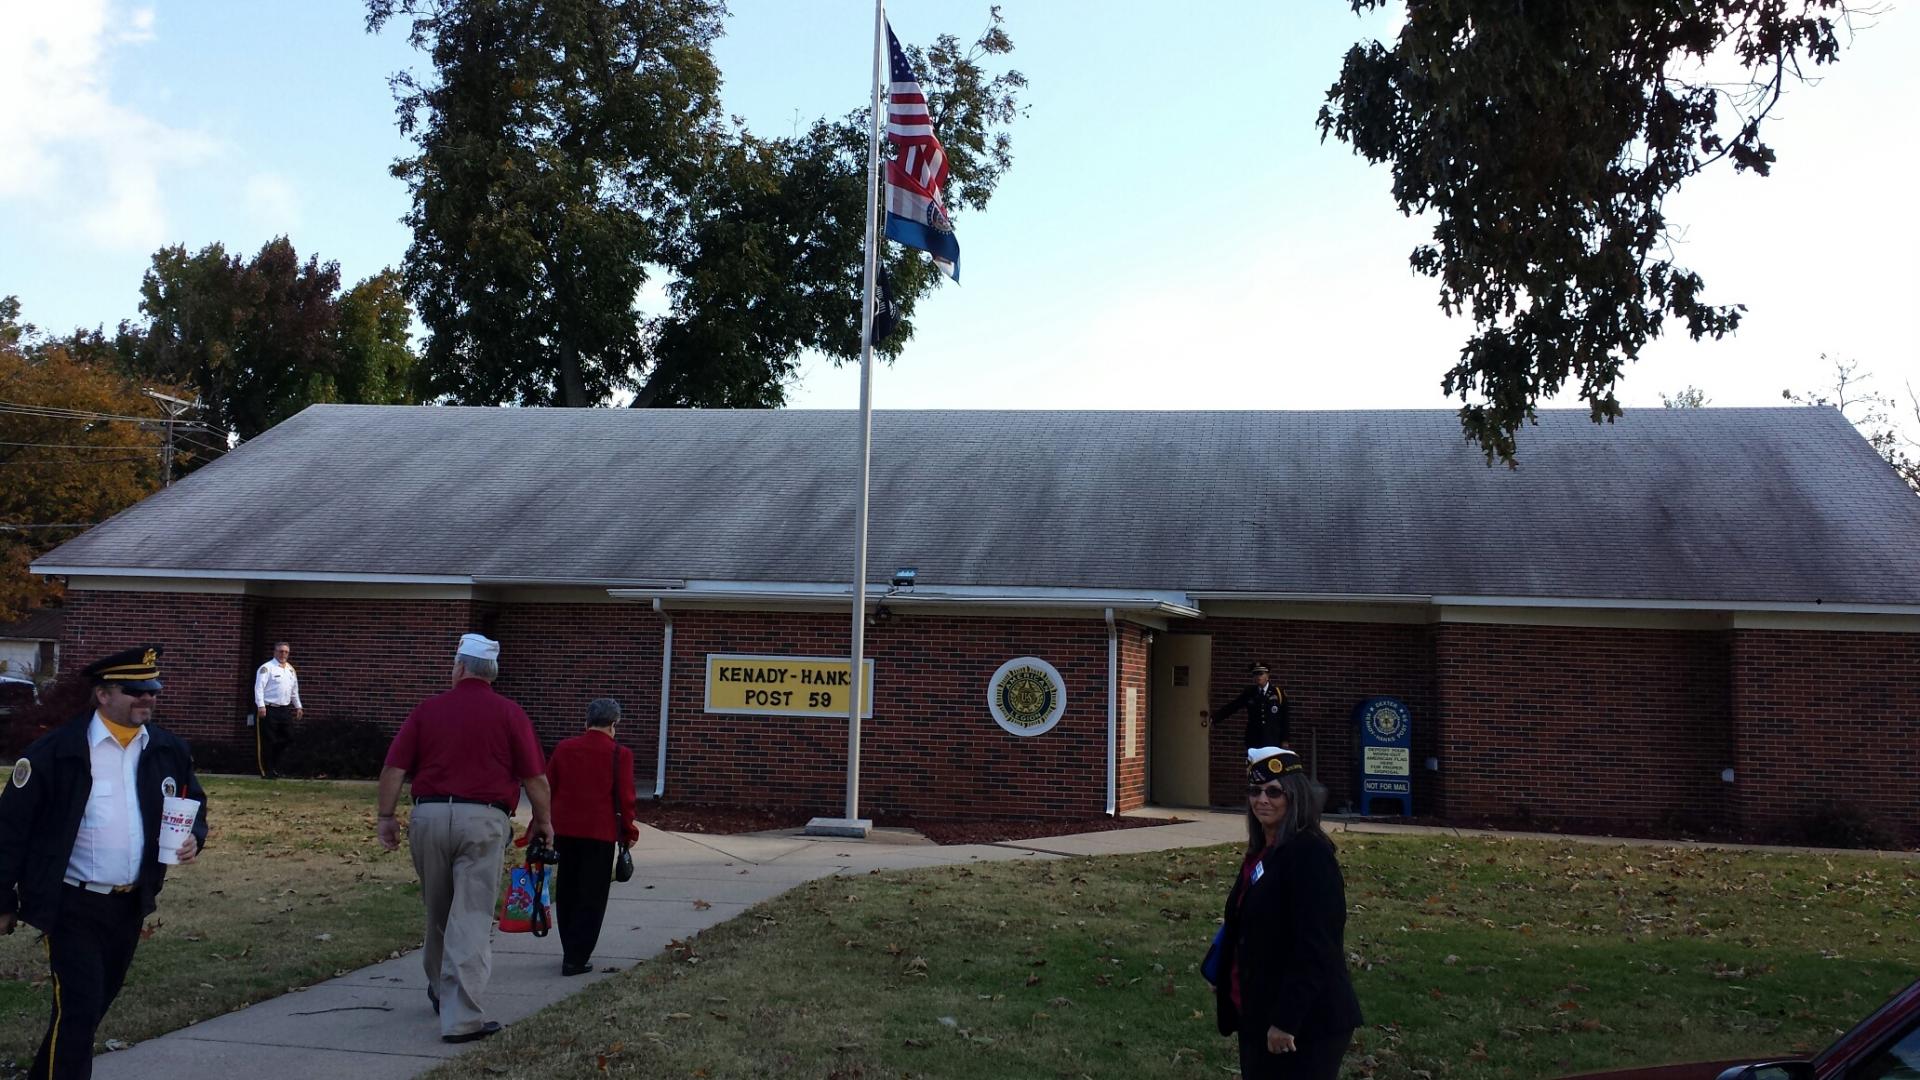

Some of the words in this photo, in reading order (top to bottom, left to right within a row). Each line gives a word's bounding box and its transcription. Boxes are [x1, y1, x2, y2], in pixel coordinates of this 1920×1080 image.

[1006, 672, 1050, 692] AMERICAN
[745, 690, 793, 706] POST
[808, 692, 832, 708] 59
[1010, 710, 1041, 721] LEGION
[1393, 783, 1407, 791] MAIL
